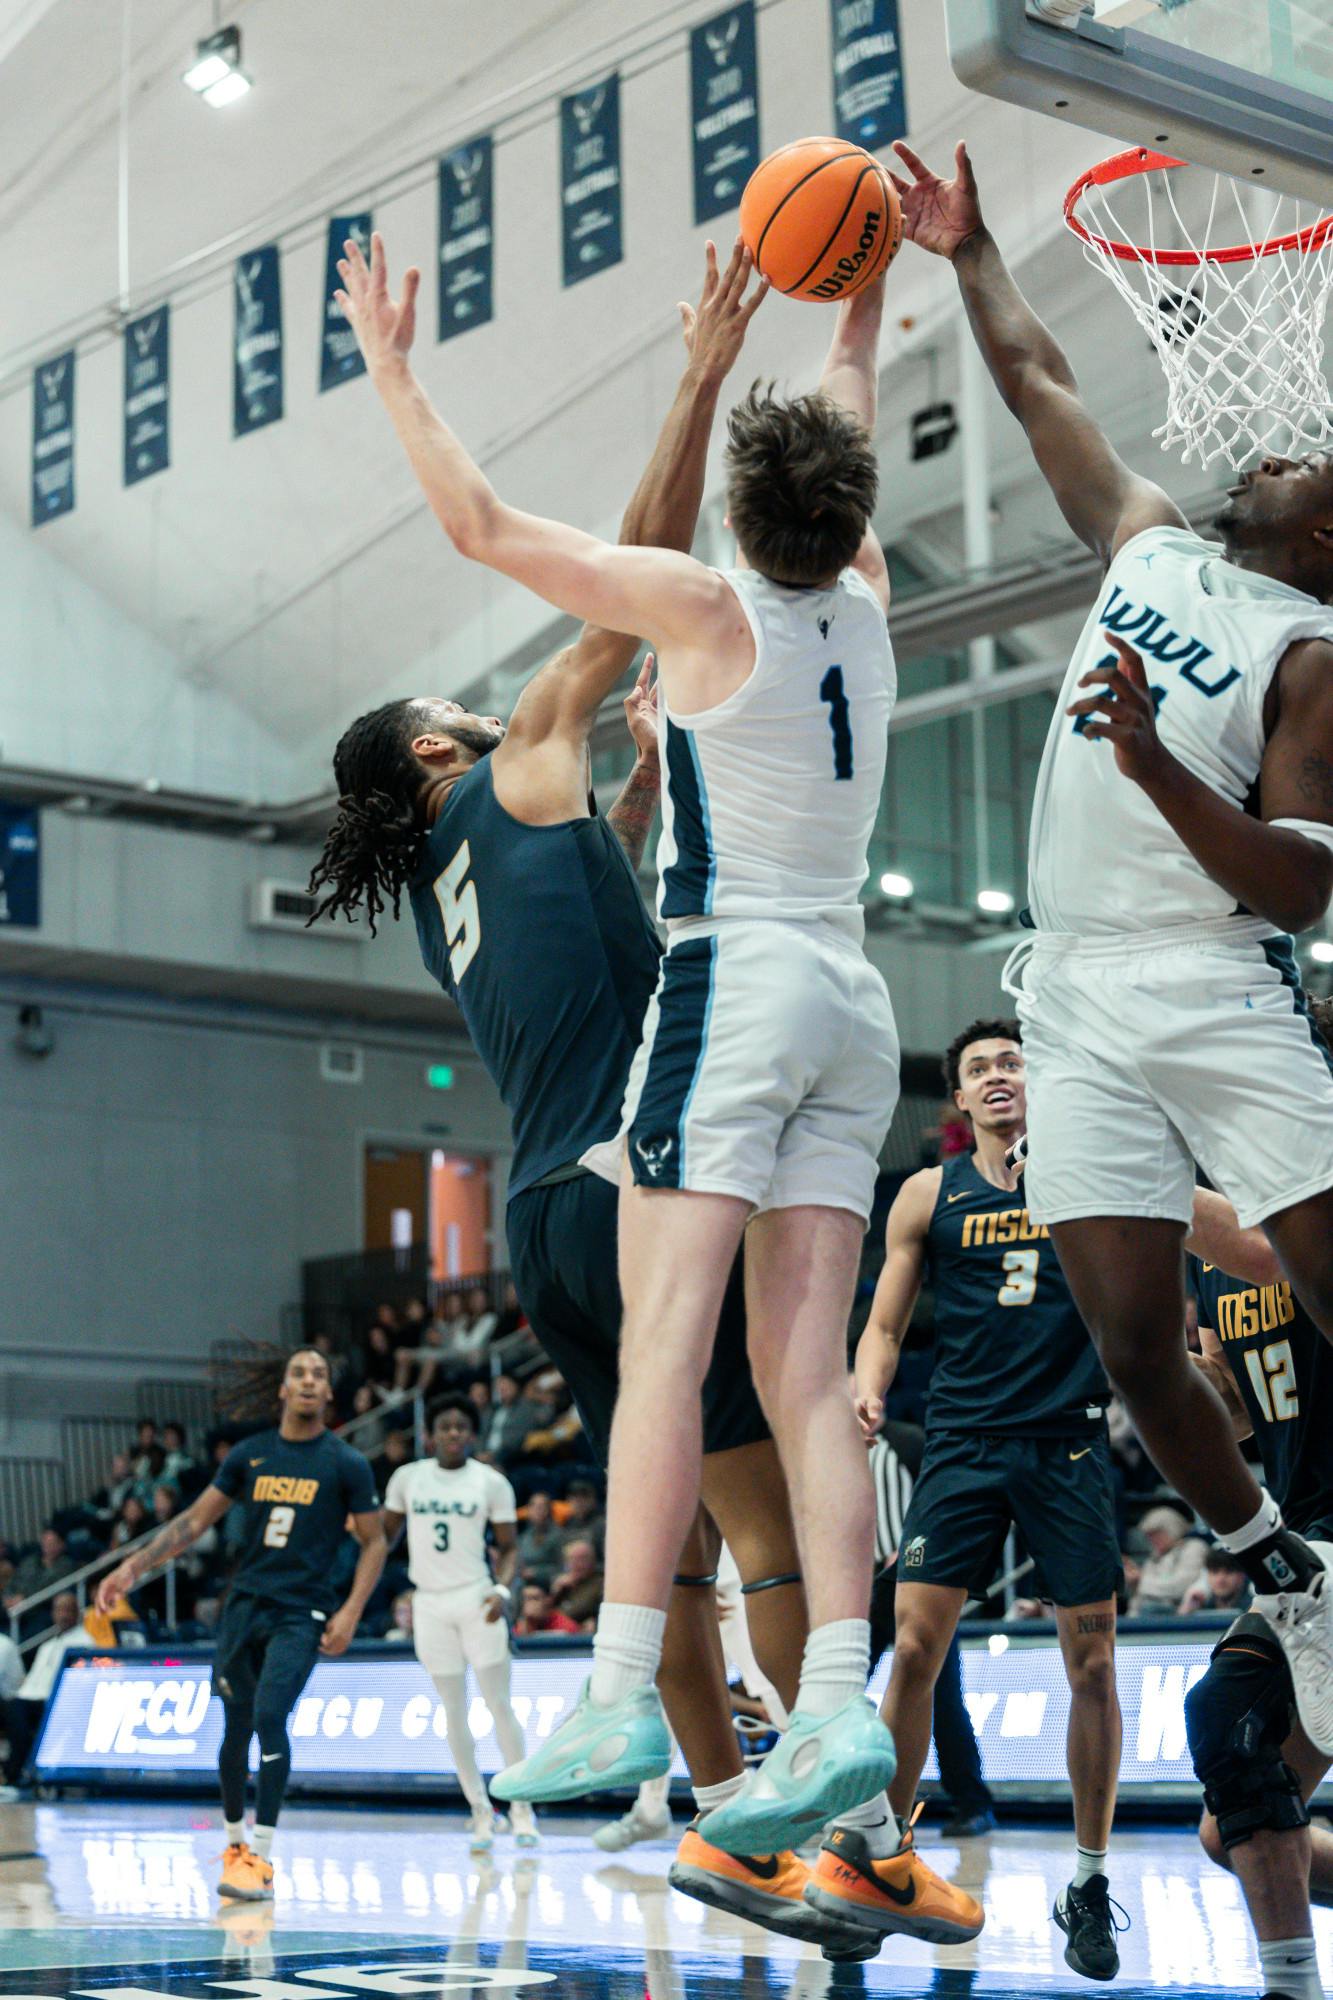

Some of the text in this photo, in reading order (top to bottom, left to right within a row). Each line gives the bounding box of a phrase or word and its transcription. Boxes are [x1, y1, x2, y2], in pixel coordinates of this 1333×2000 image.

[806, 211, 880, 298] Wilson
[1099, 584, 1242, 698] WWU
[820, 664, 853, 780] 1
[432, 838, 481, 986] 5
[997, 1249, 1040, 1306] 3
[1217, 1281, 1296, 1342] MSUB
[1244, 1338, 1300, 1423] 12
[253, 1475, 320, 1505] MSUB
[263, 1506, 296, 1549] 2
[432, 1522, 451, 1553] 3
[84, 1680, 212, 1755] WECU
[291, 1695, 386, 1740] ECU
